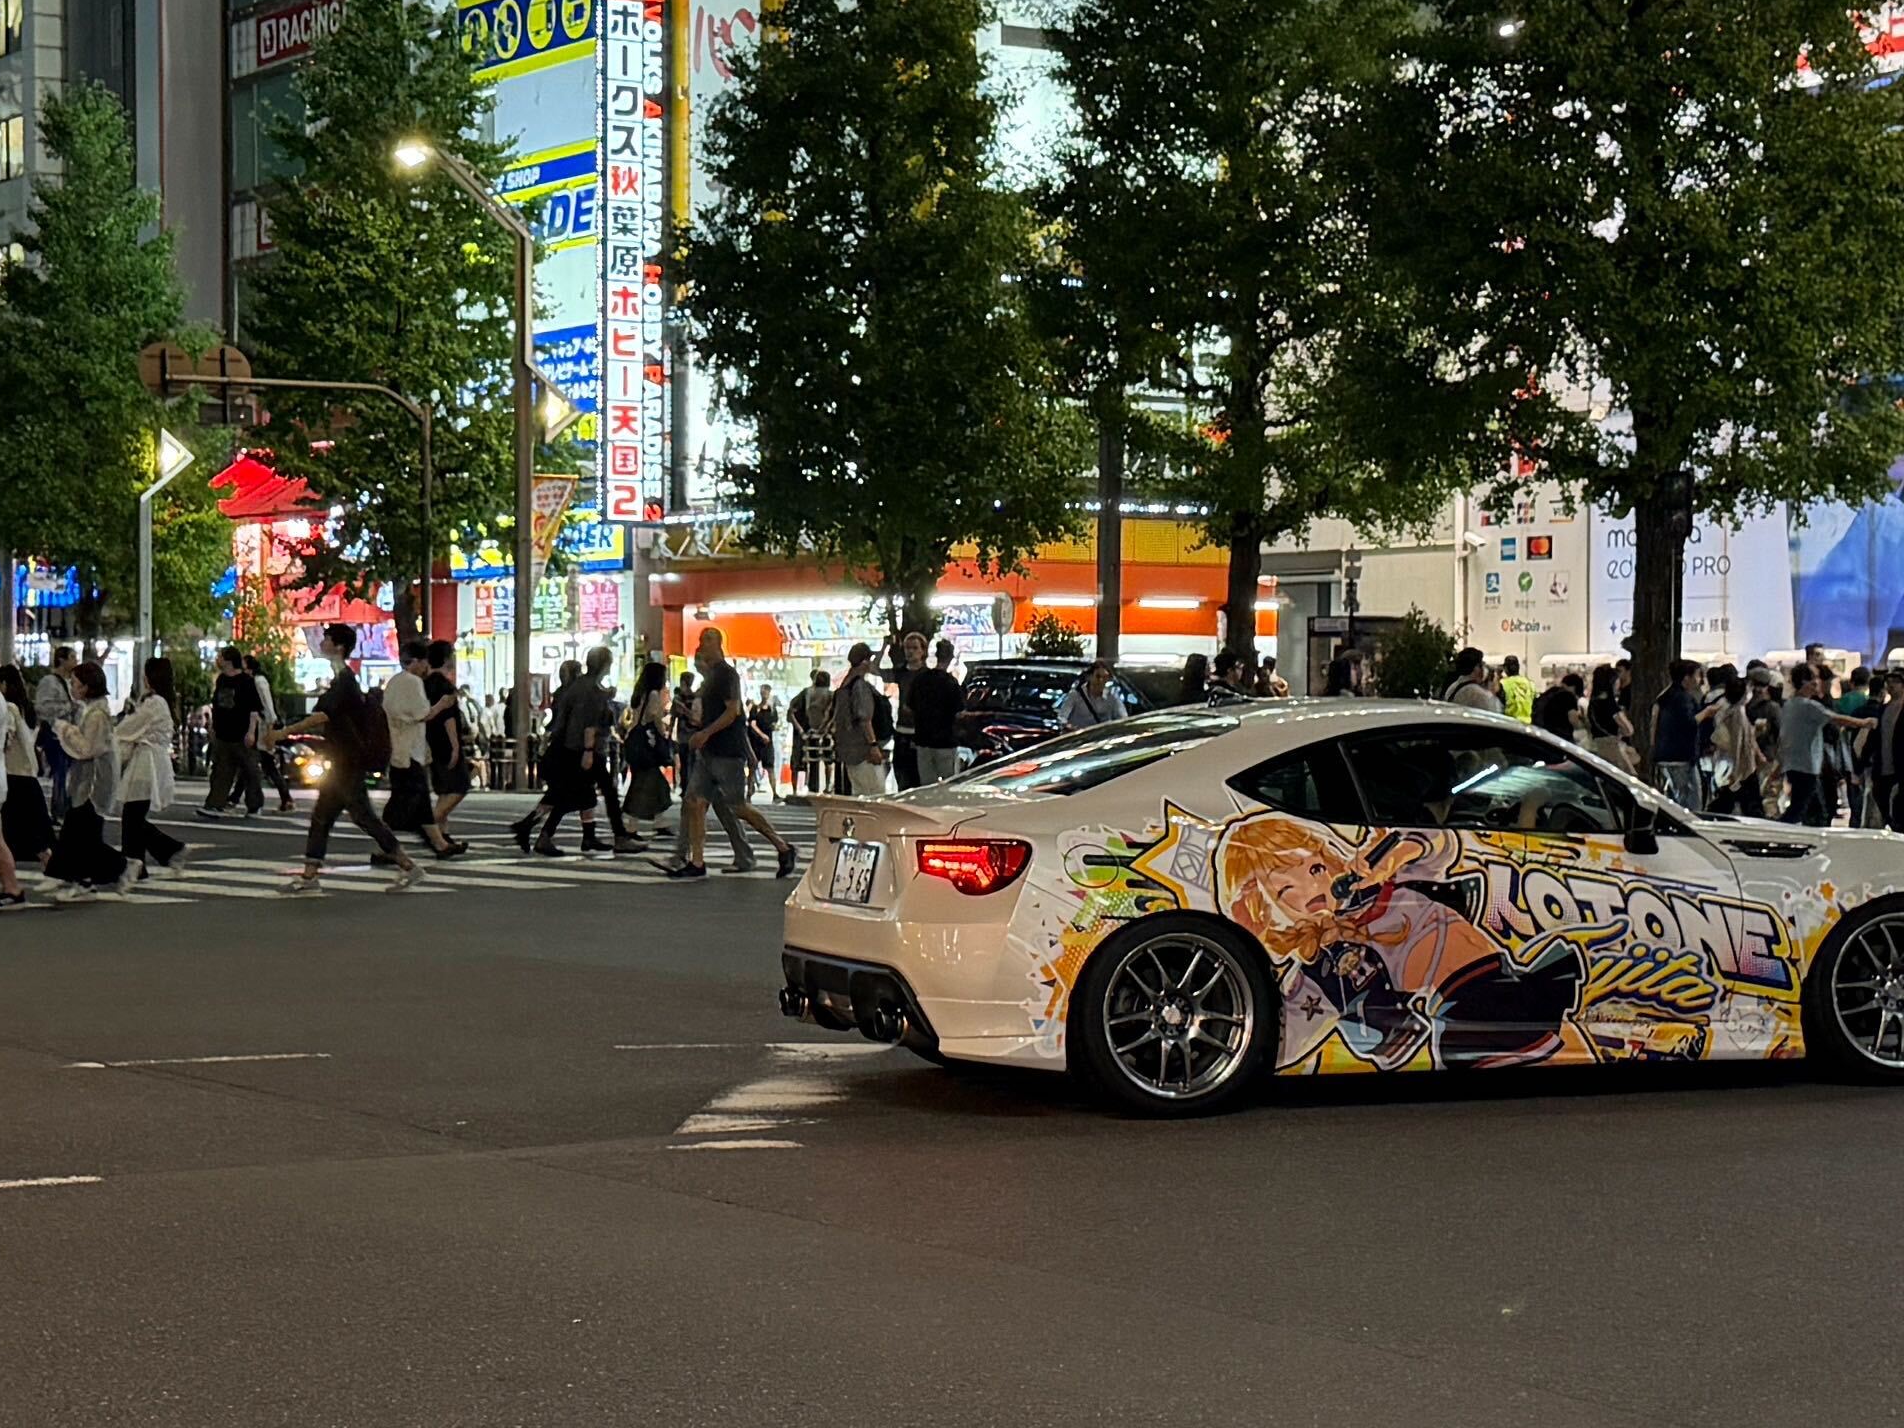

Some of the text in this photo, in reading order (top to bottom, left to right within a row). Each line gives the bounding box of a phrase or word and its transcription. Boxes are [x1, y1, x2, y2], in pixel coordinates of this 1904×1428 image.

[643, 4, 664, 96] VOLKS
[504, 167, 541, 190] SHOP
[642, 263, 663, 361] HOBBY
[642, 365, 663, 498] PARADISE
[1693, 555, 1731, 575] PRO
